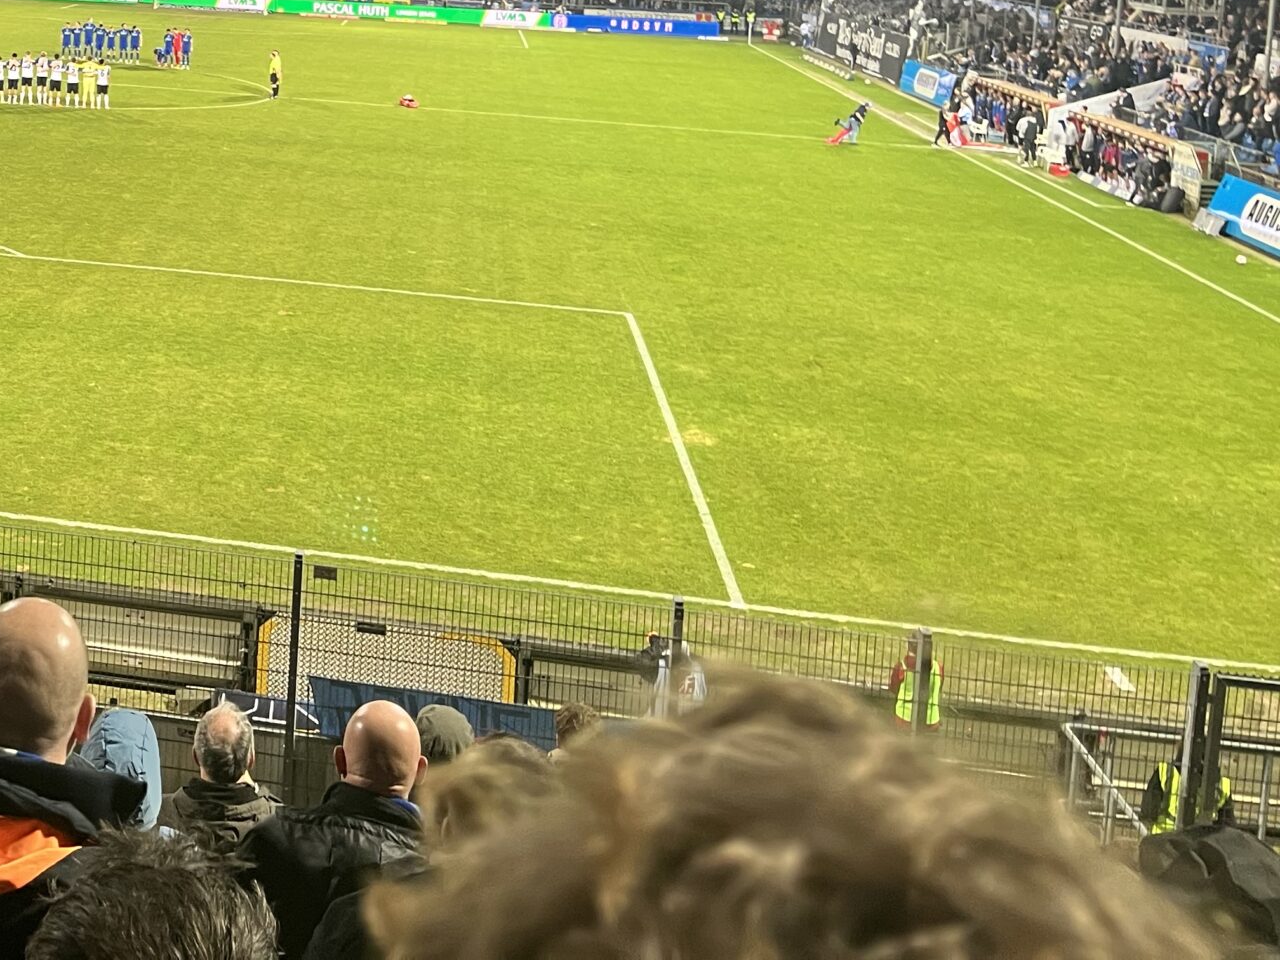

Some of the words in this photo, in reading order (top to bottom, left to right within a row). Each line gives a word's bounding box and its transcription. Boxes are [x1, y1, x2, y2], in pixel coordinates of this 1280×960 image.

[313, 2, 354, 16] PASCAL
[359, 5, 389, 17] HUTH
[496, 12, 517, 21] LVM
